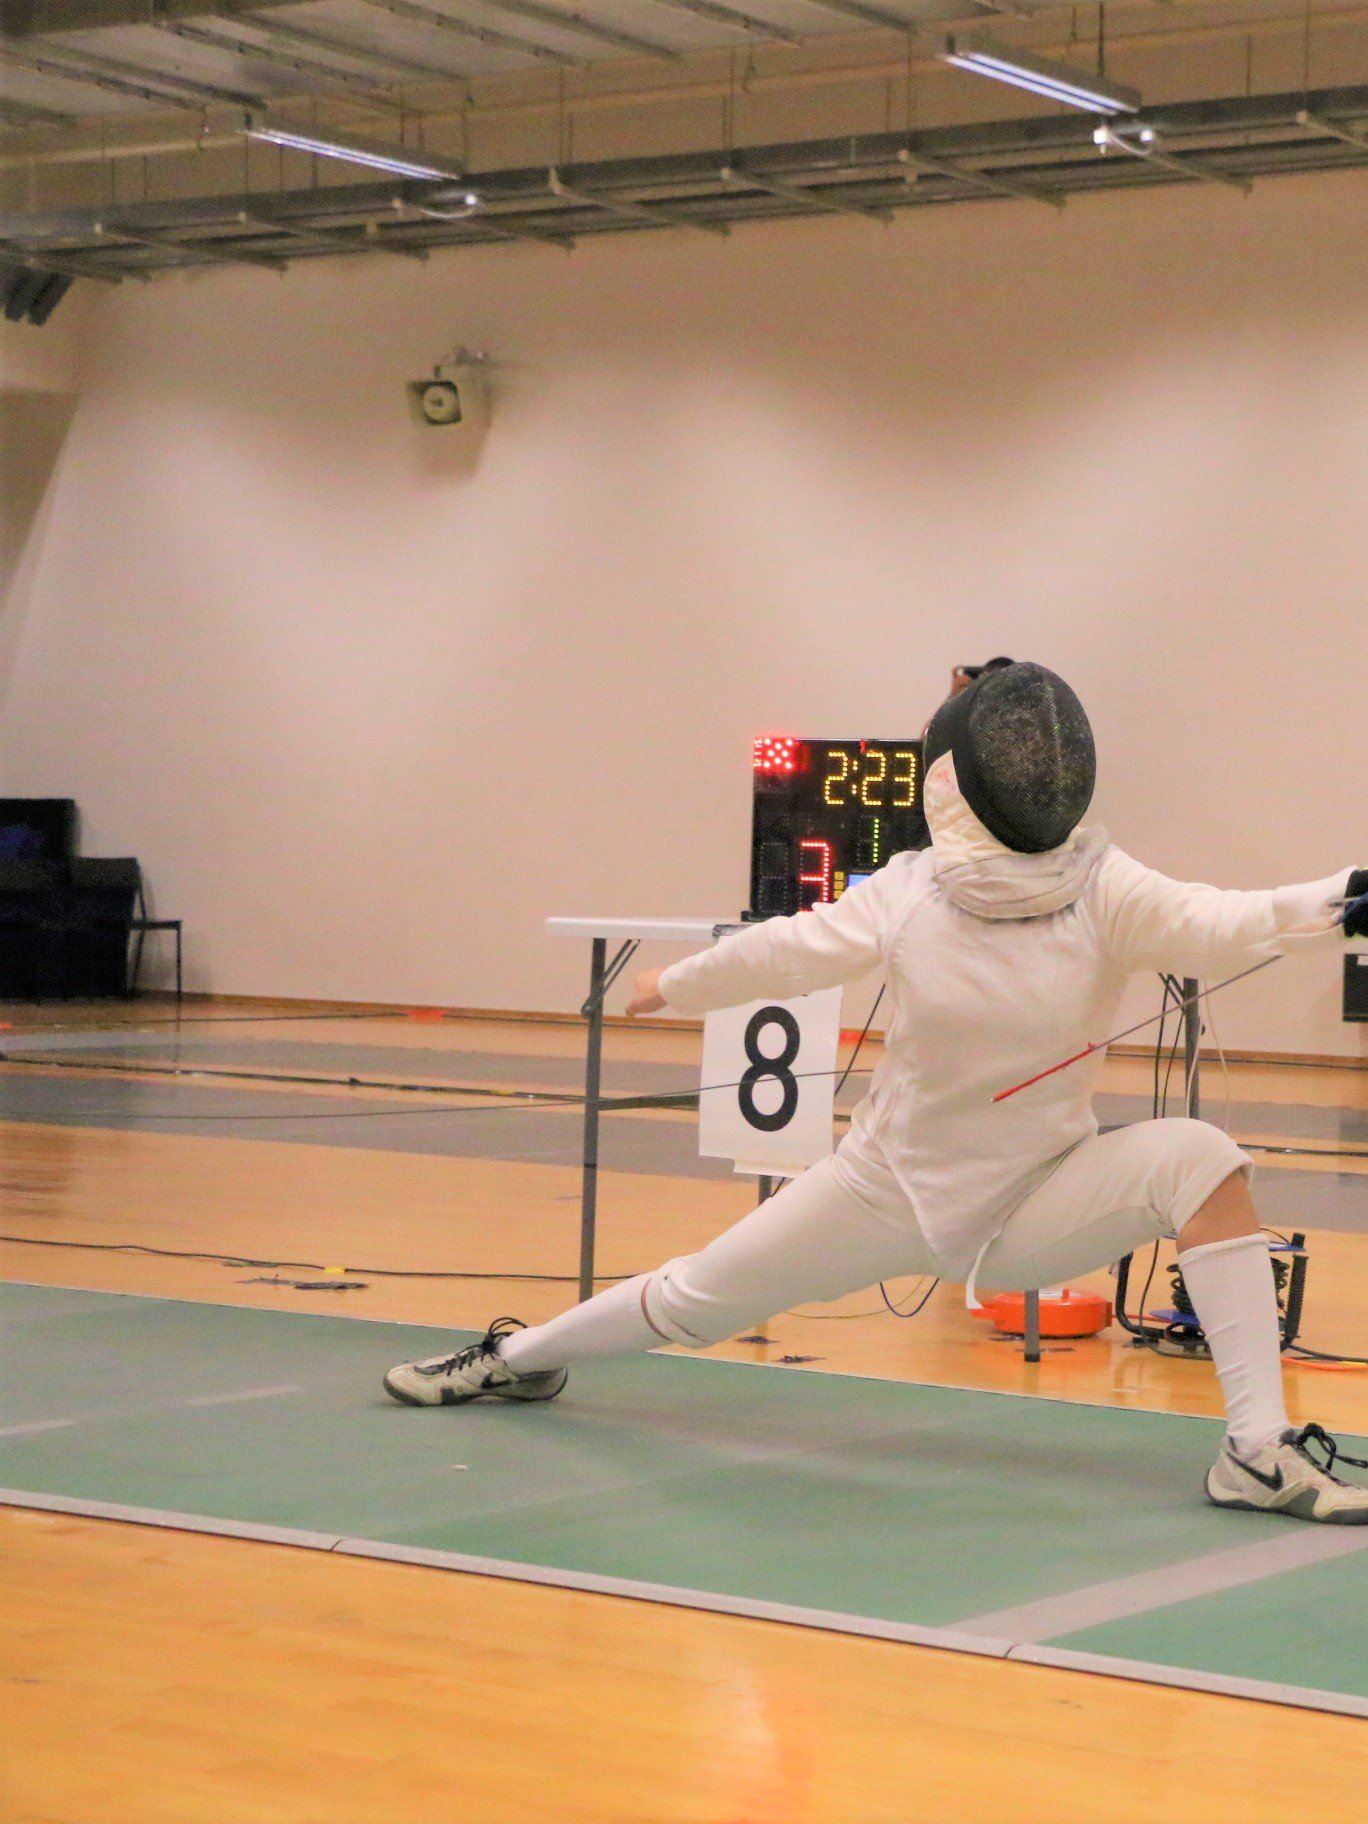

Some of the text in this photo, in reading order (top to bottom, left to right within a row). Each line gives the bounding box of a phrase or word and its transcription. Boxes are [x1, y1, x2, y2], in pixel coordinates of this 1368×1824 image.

[823, 751, 916, 806] 2:23
[800, 841, 831, 914] 3
[738, 1006, 800, 1132] 8
